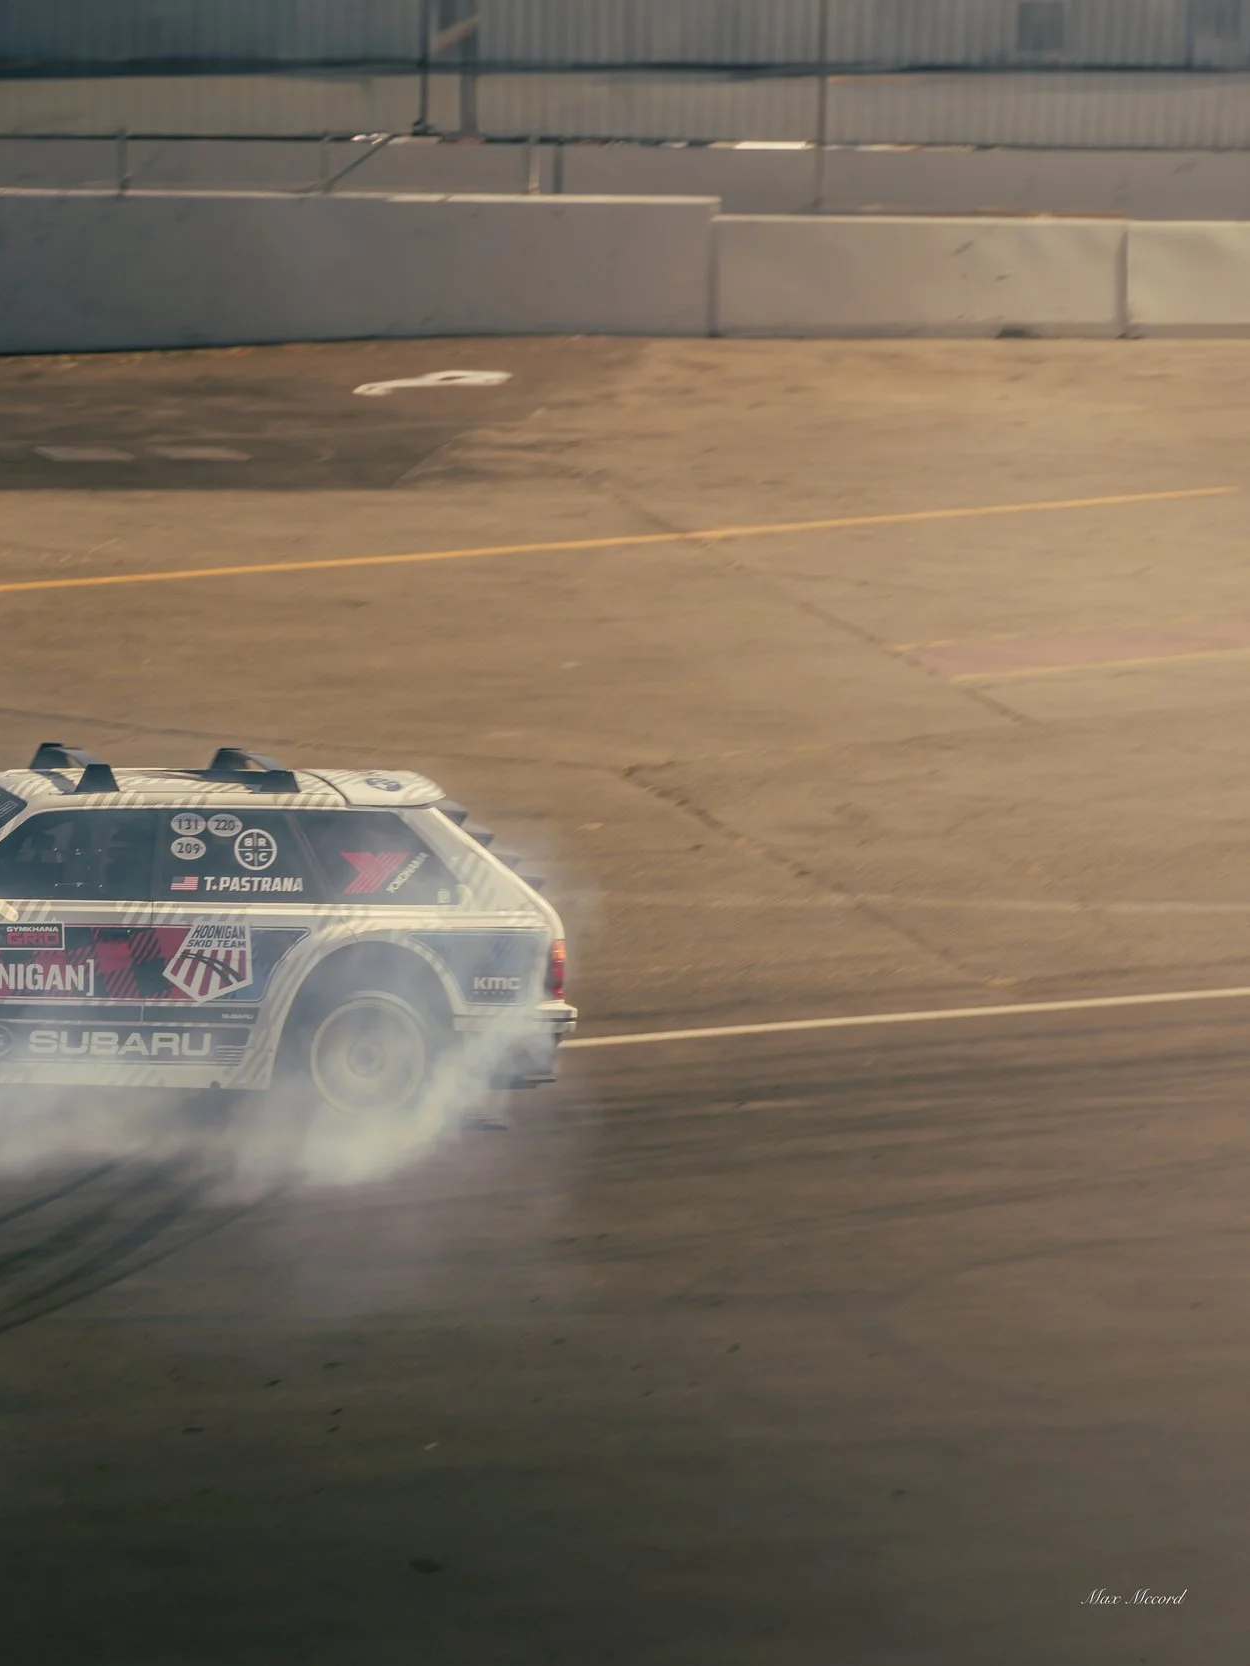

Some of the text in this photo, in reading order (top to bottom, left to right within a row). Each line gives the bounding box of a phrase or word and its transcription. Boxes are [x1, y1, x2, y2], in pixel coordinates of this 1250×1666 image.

[177, 818, 199, 830] 131
[177, 842, 201, 855] 209
[191, 924, 246, 940] HOONIGAN
[186, 939, 247, 949] SKID TEAM
[28, 1029, 212, 1056] SUBARU
